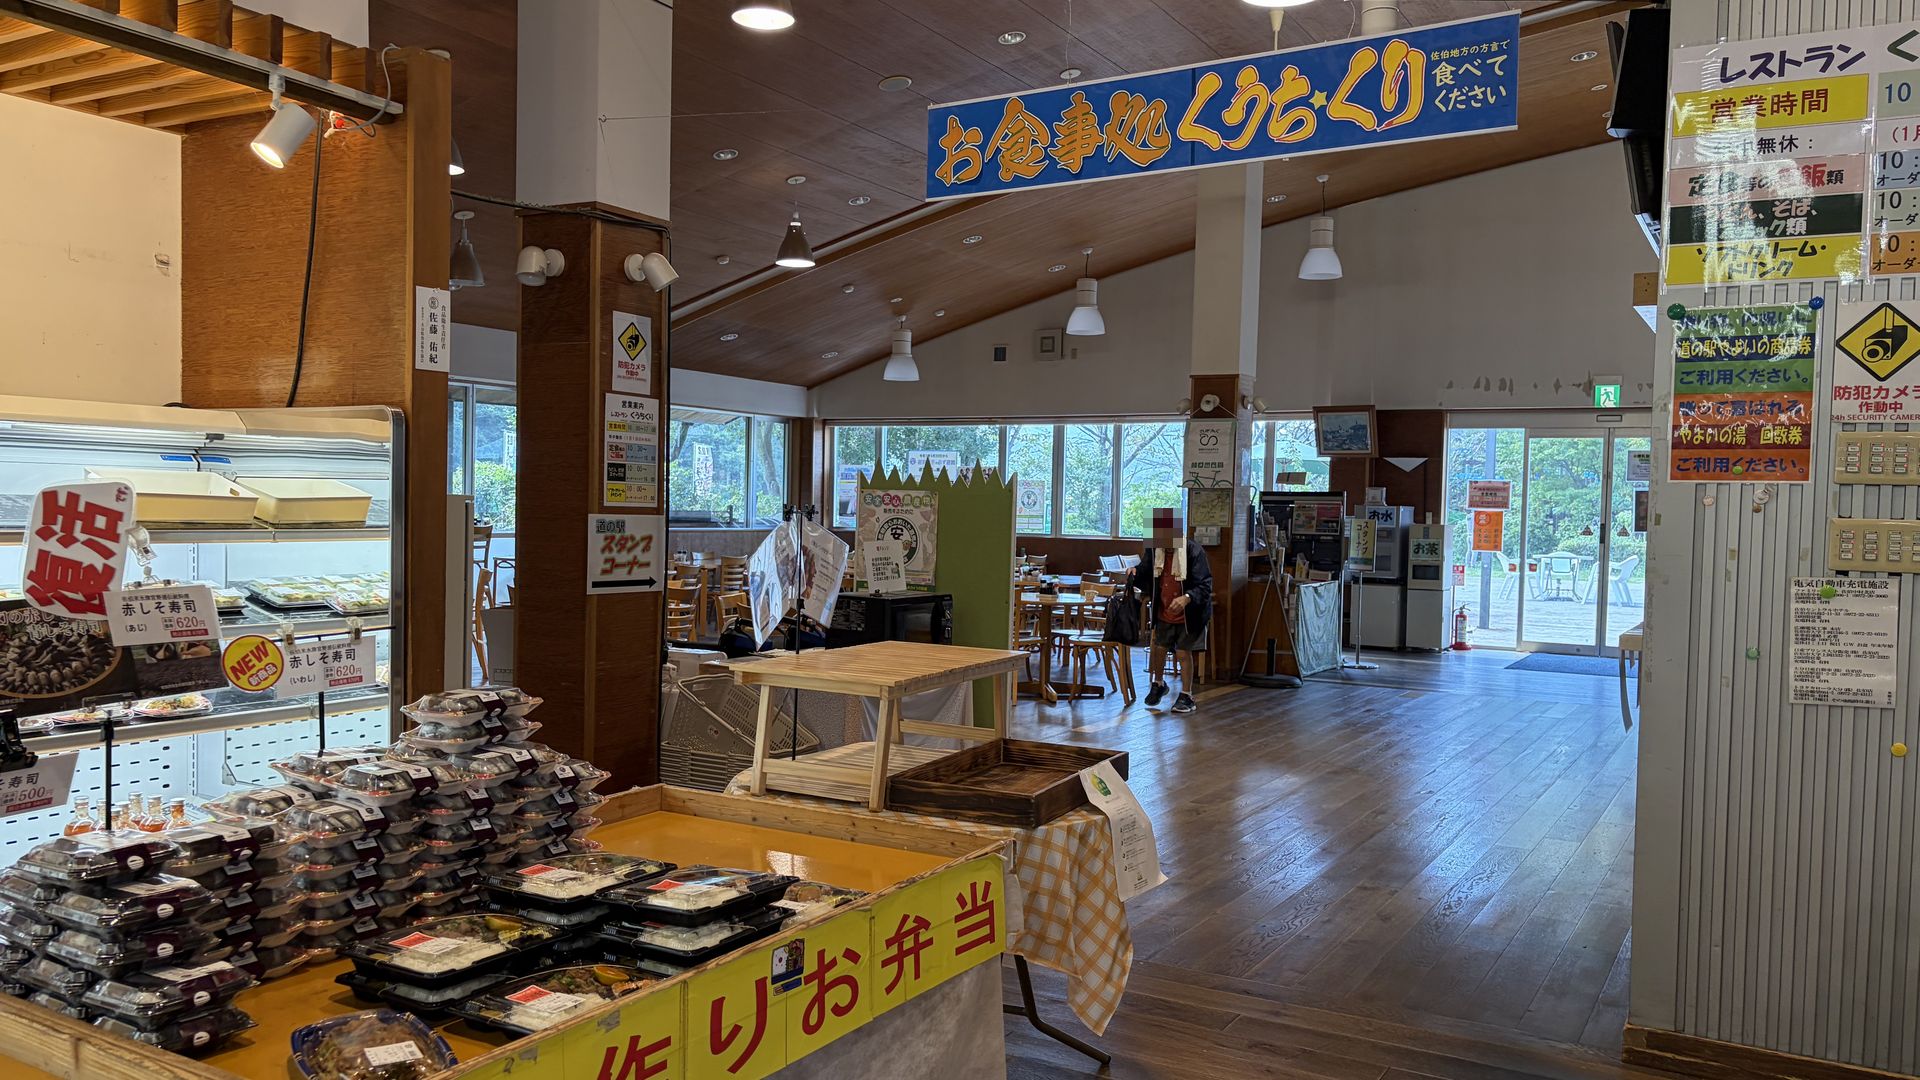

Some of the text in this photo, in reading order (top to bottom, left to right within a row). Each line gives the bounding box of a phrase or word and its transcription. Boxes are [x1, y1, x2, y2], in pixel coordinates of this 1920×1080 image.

[1431, 39, 1511, 61] 佐伯地方の方言で
[1431, 54, 1508, 87] 食べて
[1720, 43, 1867, 84] レストラン
[1434, 84, 1507, 113] ください
[1710, 88, 1829, 123] 営業時間
[935, 90, 1172, 187] お食事処
[428, 311, 439, 335] 佐藤
[1677, 336, 1813, 360] 道の駅やよいの商品券
[617, 360, 646, 372] 防犯カメラ
[1679, 367, 1809, 386] ご利用ください。
[1847, 413, 1888, 421] SECURITY
[1858, 400, 1903, 414] 作動中
[1678, 426, 1804, 446] やよいの湯 回数券
[1675, 455, 1806, 475] ご利用ください。
[596, 519, 626, 534] 道の駅
[1368, 510, 1393, 523] お水
[600, 533, 654, 554] スタンプ
[890, 525, 904, 541] 安
[1355, 524, 1363, 556] コーナー
[1362, 521, 1370, 555] スタンプ
[26, 490, 124, 616] 復活
[1412, 542, 1440, 556] お茶
[600, 555, 651, 576] コーナー
[1793, 578, 1890, 590] 電気自動車充電施設
[121, 599, 197, 617] 赤しそ寿司
[230, 640, 270, 681] NEW
[289, 648, 357, 669] 赤しそ寿司
[248, 663, 279, 687] 新商品
